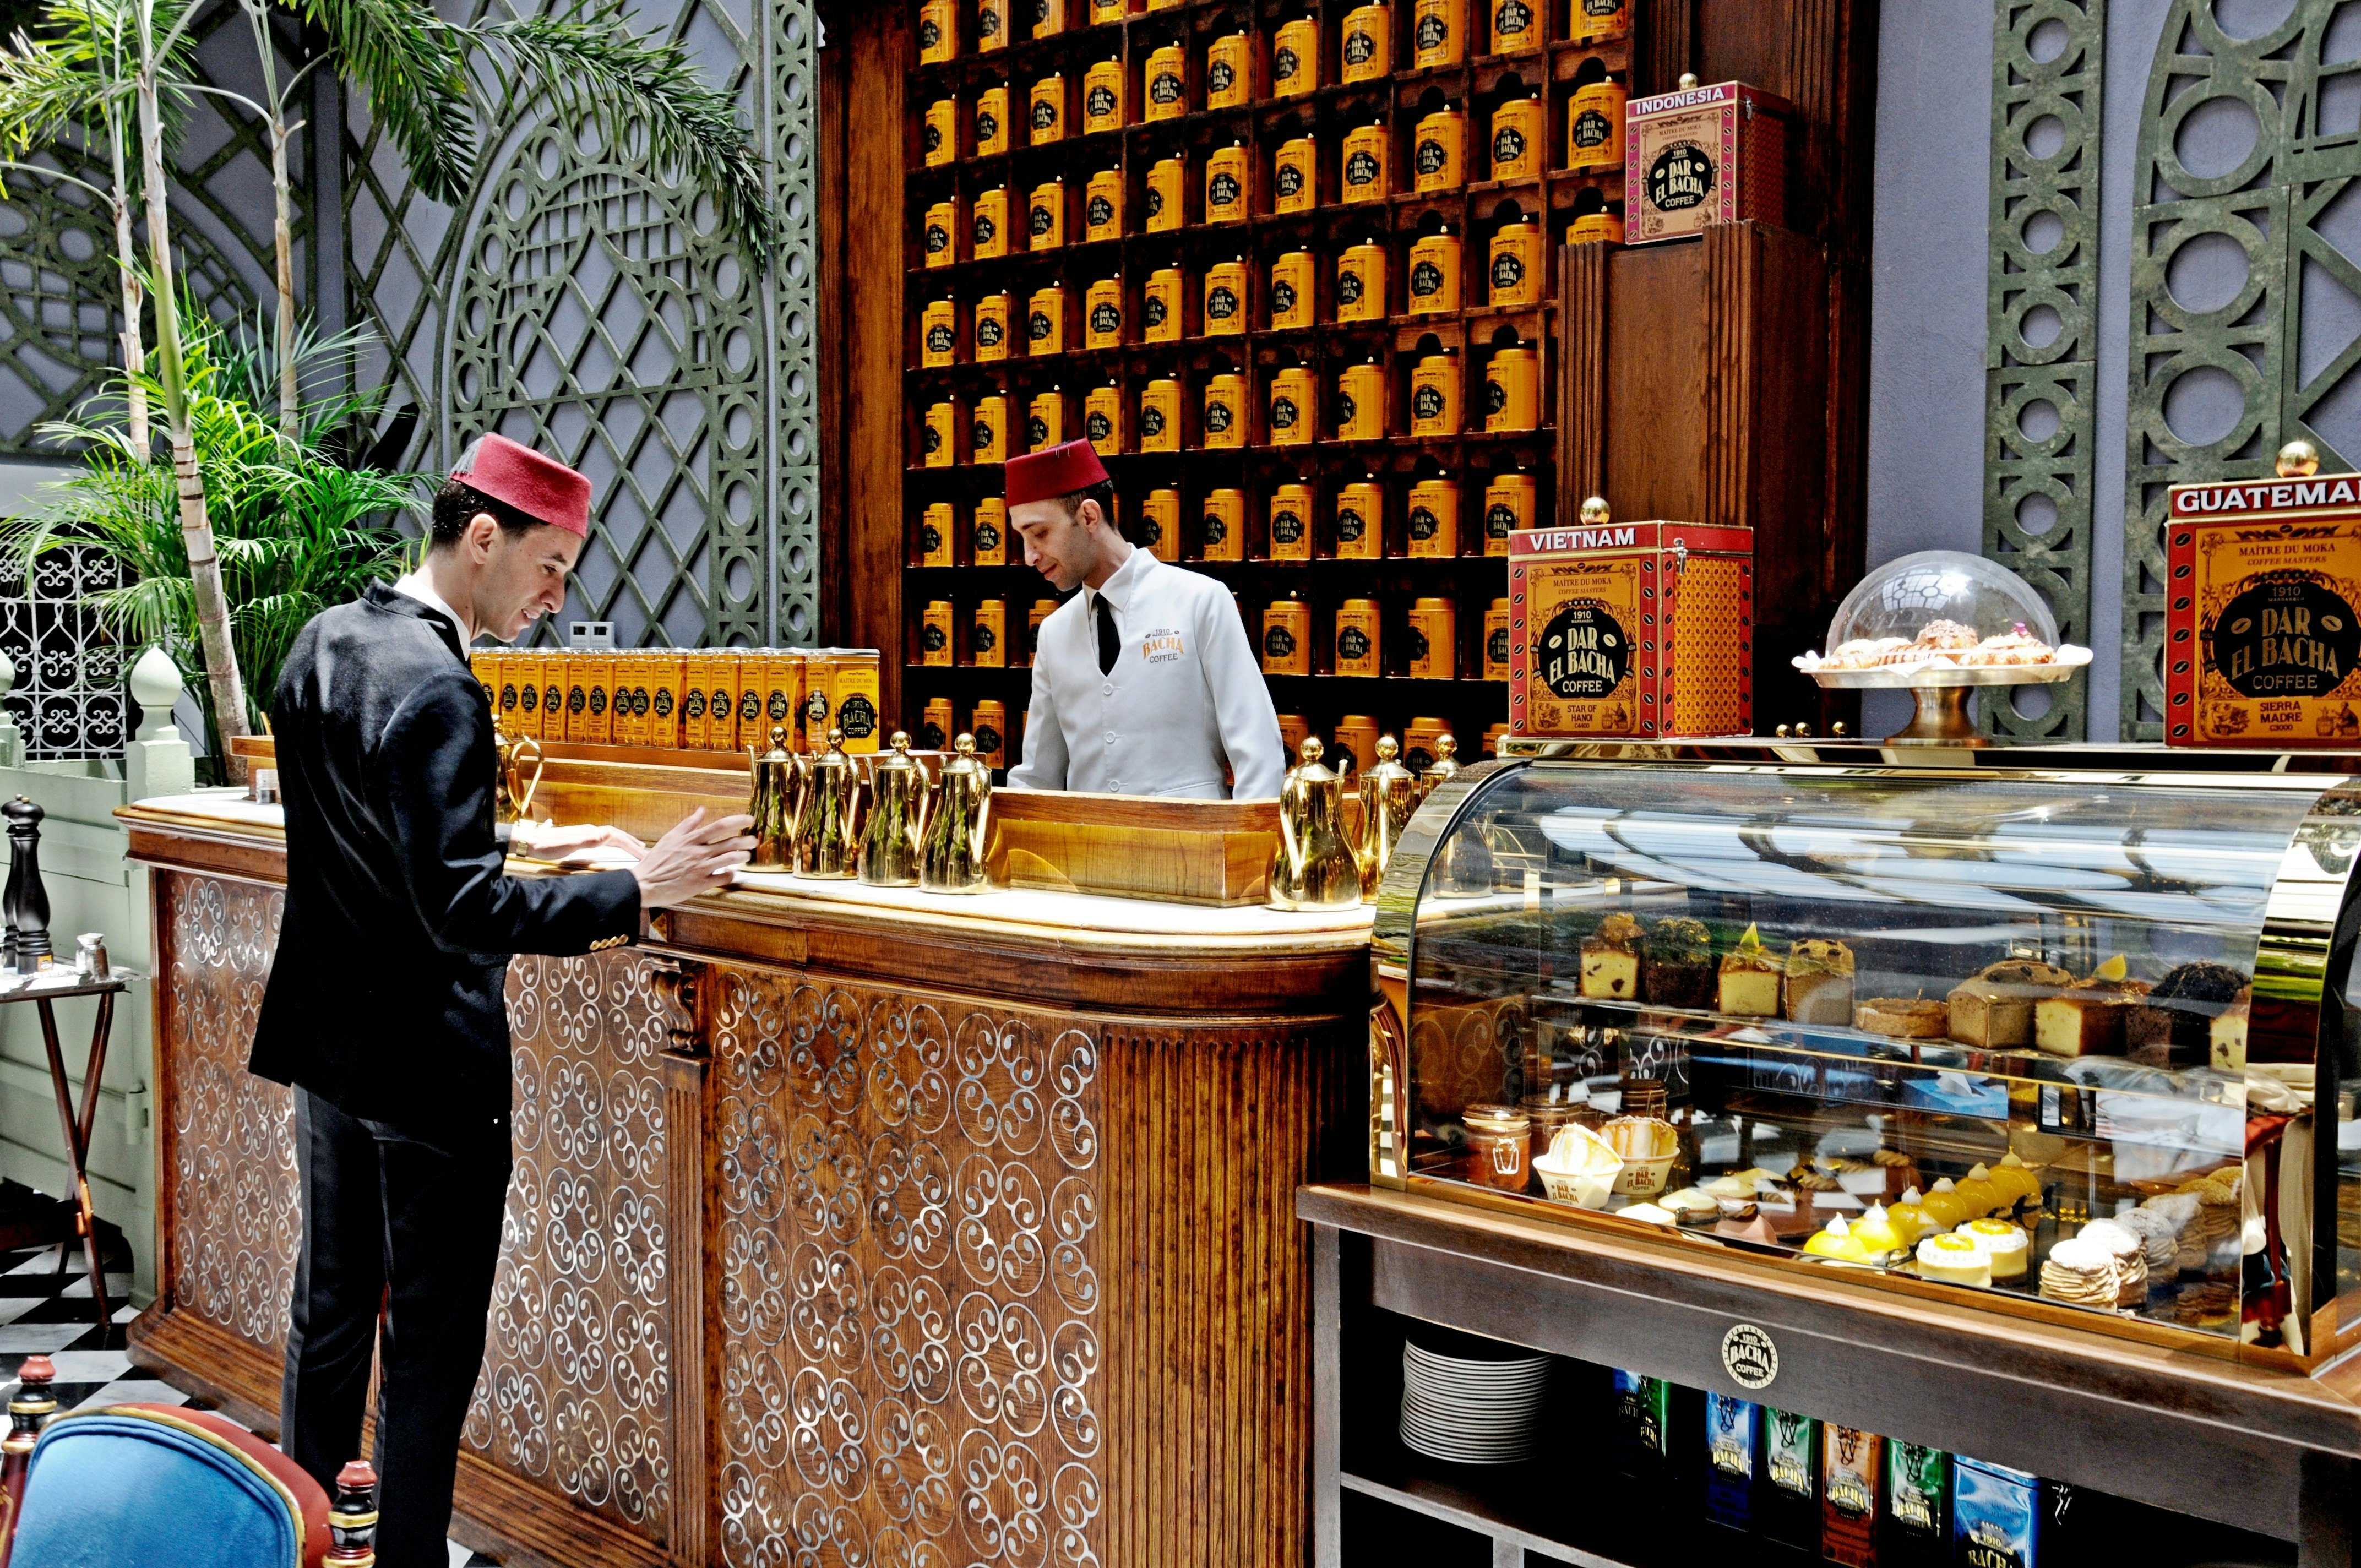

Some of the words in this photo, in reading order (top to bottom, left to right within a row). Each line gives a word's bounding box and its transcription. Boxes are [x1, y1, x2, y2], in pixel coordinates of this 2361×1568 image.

[1505, 7, 1517, 17] DAR
[1505, 17, 1525, 28] BACHA
[1160, 88, 1177, 98] BACHA
[1094, 100, 1111, 111] BACHA
[1636, 88, 1724, 115] INDONESIA
[1583, 119, 1596, 129] DAR
[1500, 135, 1511, 145] DAR
[1583, 128, 1603, 140] BACHA
[1500, 144, 1518, 155] BACHA
[1673, 149, 1687, 157] 1910
[1354, 160, 1366, 168] DAR
[1669, 159, 1691, 179] DAR
[1354, 168, 1372, 179] BACHA
[1656, 183, 1667, 204] EL
[1669, 176, 1704, 197] BACHA
[1665, 195, 1694, 208] COFFEE
[1499, 262, 1510, 270] DAR
[1499, 270, 1517, 282] BACHA
[1215, 295, 1225, 303] DAR
[1215, 303, 1232, 313] BACHA
[1099, 317, 1116, 329] BACHA
[934, 338, 951, 347] BACHA
[2177, 481, 2361, 512] GUATEMA
[1530, 528, 1634, 551] VIETNAM
[2239, 545, 2281, 556] MAÎTRE
[2284, 545, 2299, 553] DU
[2303, 543, 2336, 553] MOKA
[2247, 558, 2280, 567] COFFEE
[2284, 556, 2327, 564] MASTERS
[1553, 579, 1577, 587] MAÎTRE
[2272, 586, 2301, 597] 1910
[1574, 611, 1591, 619] 1910
[2262, 606, 2311, 637] DAR
[1568, 627, 1597, 651] DAR
[1143, 637, 1184, 660] BACHA
[1149, 653, 1178, 663] COFFEE
[2232, 645, 2255, 681] EL
[2262, 636, 2340, 679] BACHA
[1550, 657, 1564, 685] EL
[1568, 650, 1615, 685] BACHA
[1563, 680, 1603, 693] COFFEE
[2253, 674, 2318, 690] COFFEE
[688, 699, 703, 711] BACHA
[712, 700, 727, 712] BACHA
[743, 700, 758, 714] BACHA
[770, 701, 785, 714] BACHA
[1568, 705, 1586, 713] STAR
[2260, 700, 2301, 712] SIERRA
[843, 710, 872, 730] BACHA
[1571, 713, 1593, 721] HANOI
[2260, 712, 2302, 723] MADRE
[1557, 1184, 1569, 1193] DAR
[1635, 1178, 1655, 1188] BACHA
[1558, 1191, 1579, 1204] BACHA
[1742, 1333, 1758, 1343] 1910
[1730, 1344, 1770, 1373] BACHA
[1736, 1363, 1764, 1377] COFFEE
[1713, 1450, 1743, 1473] BACHA
[1772, 1466, 1804, 1490] BACHA
[1832, 1485, 1865, 1510] BACHA
[1896, 1502, 1932, 1527] BACHA
[1982, 1534, 2001, 1547] 1910
[1968, 1549, 2012, 1568] BACH
